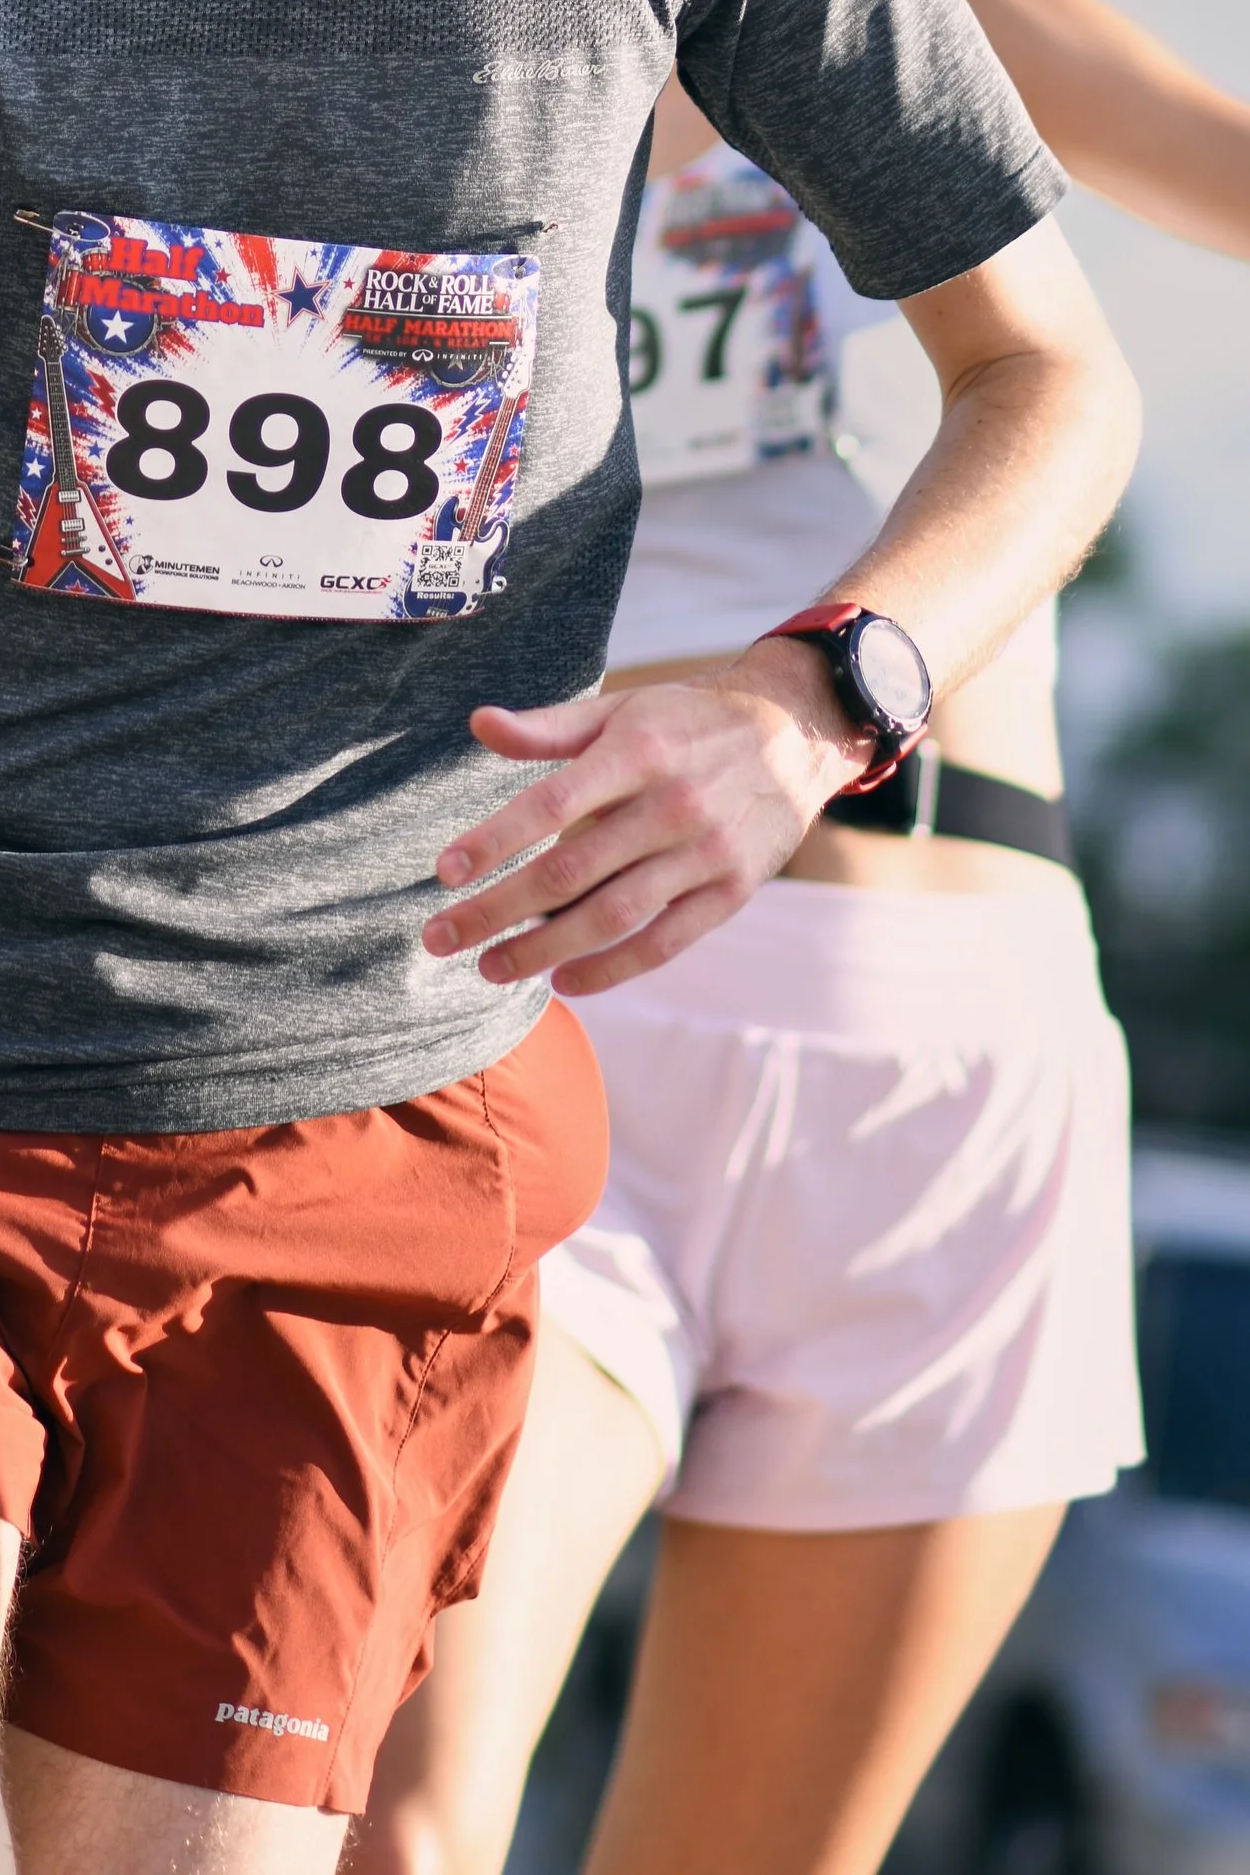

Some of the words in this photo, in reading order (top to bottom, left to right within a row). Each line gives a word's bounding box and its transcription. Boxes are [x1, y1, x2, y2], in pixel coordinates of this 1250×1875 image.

[110, 236, 205, 281] Half
[366, 269, 429, 294] ROCK
[440, 275, 495, 295] ROLL
[79, 275, 265, 328] Marathon
[363, 290, 423, 312] HALL
[422, 294, 438, 305] OF
[437, 295, 494, 314] FAME
[344, 313, 397, 333] HALF
[404, 319, 514, 339] MARATHON
[363, 348, 398, 357] PRESENTED
[437, 353, 483, 361] INFINITI
[105, 378, 443, 521] 898
[154, 569, 188, 578] WORKFORCE
[189, 572, 219, 581] SOLUTIONS
[155, 560, 220, 574] MINUTEMEN
[239, 570, 300, 580] INFINITI
[231, 578, 277, 588] BEACHWOOD
[215, 1702, 330, 1742] patagonia
